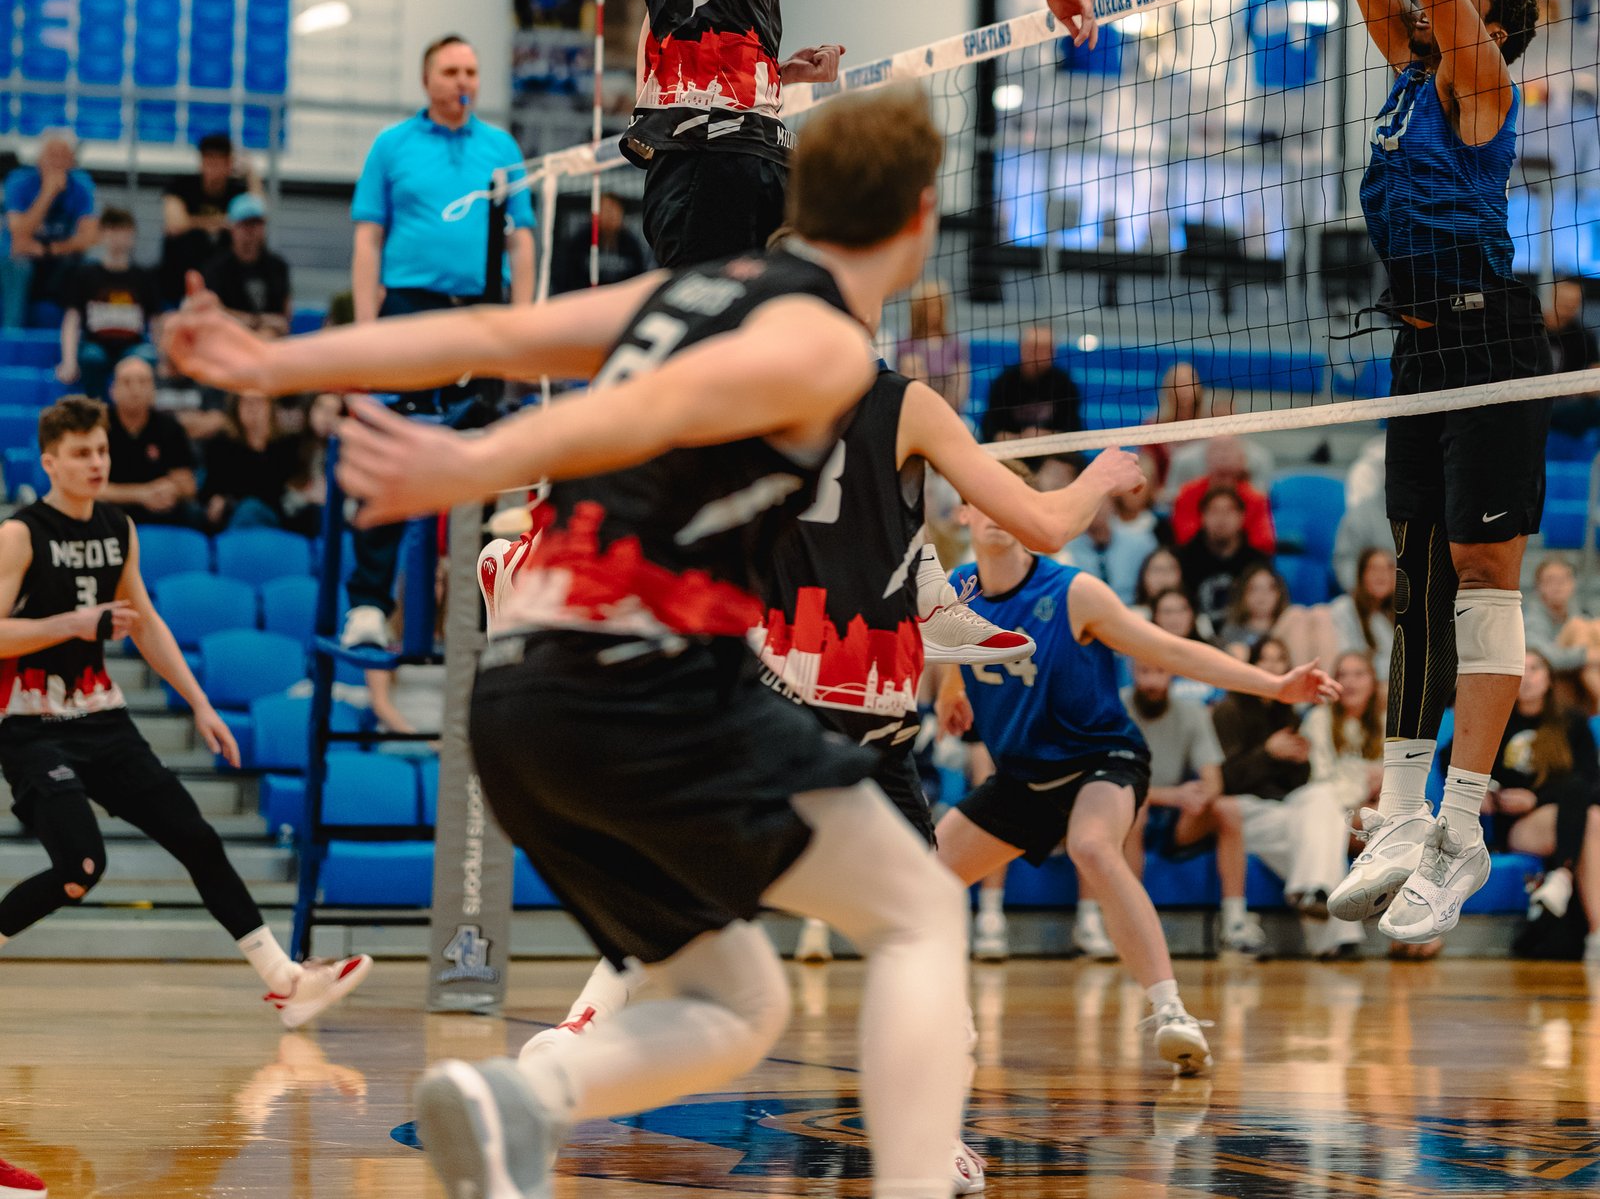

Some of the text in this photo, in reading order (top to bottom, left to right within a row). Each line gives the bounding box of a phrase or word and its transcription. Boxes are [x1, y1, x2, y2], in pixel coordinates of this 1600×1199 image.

[963, 22, 1012, 58] SPARTANS
[49, 537, 123, 569] MSOE
[75, 575, 98, 611] 3
